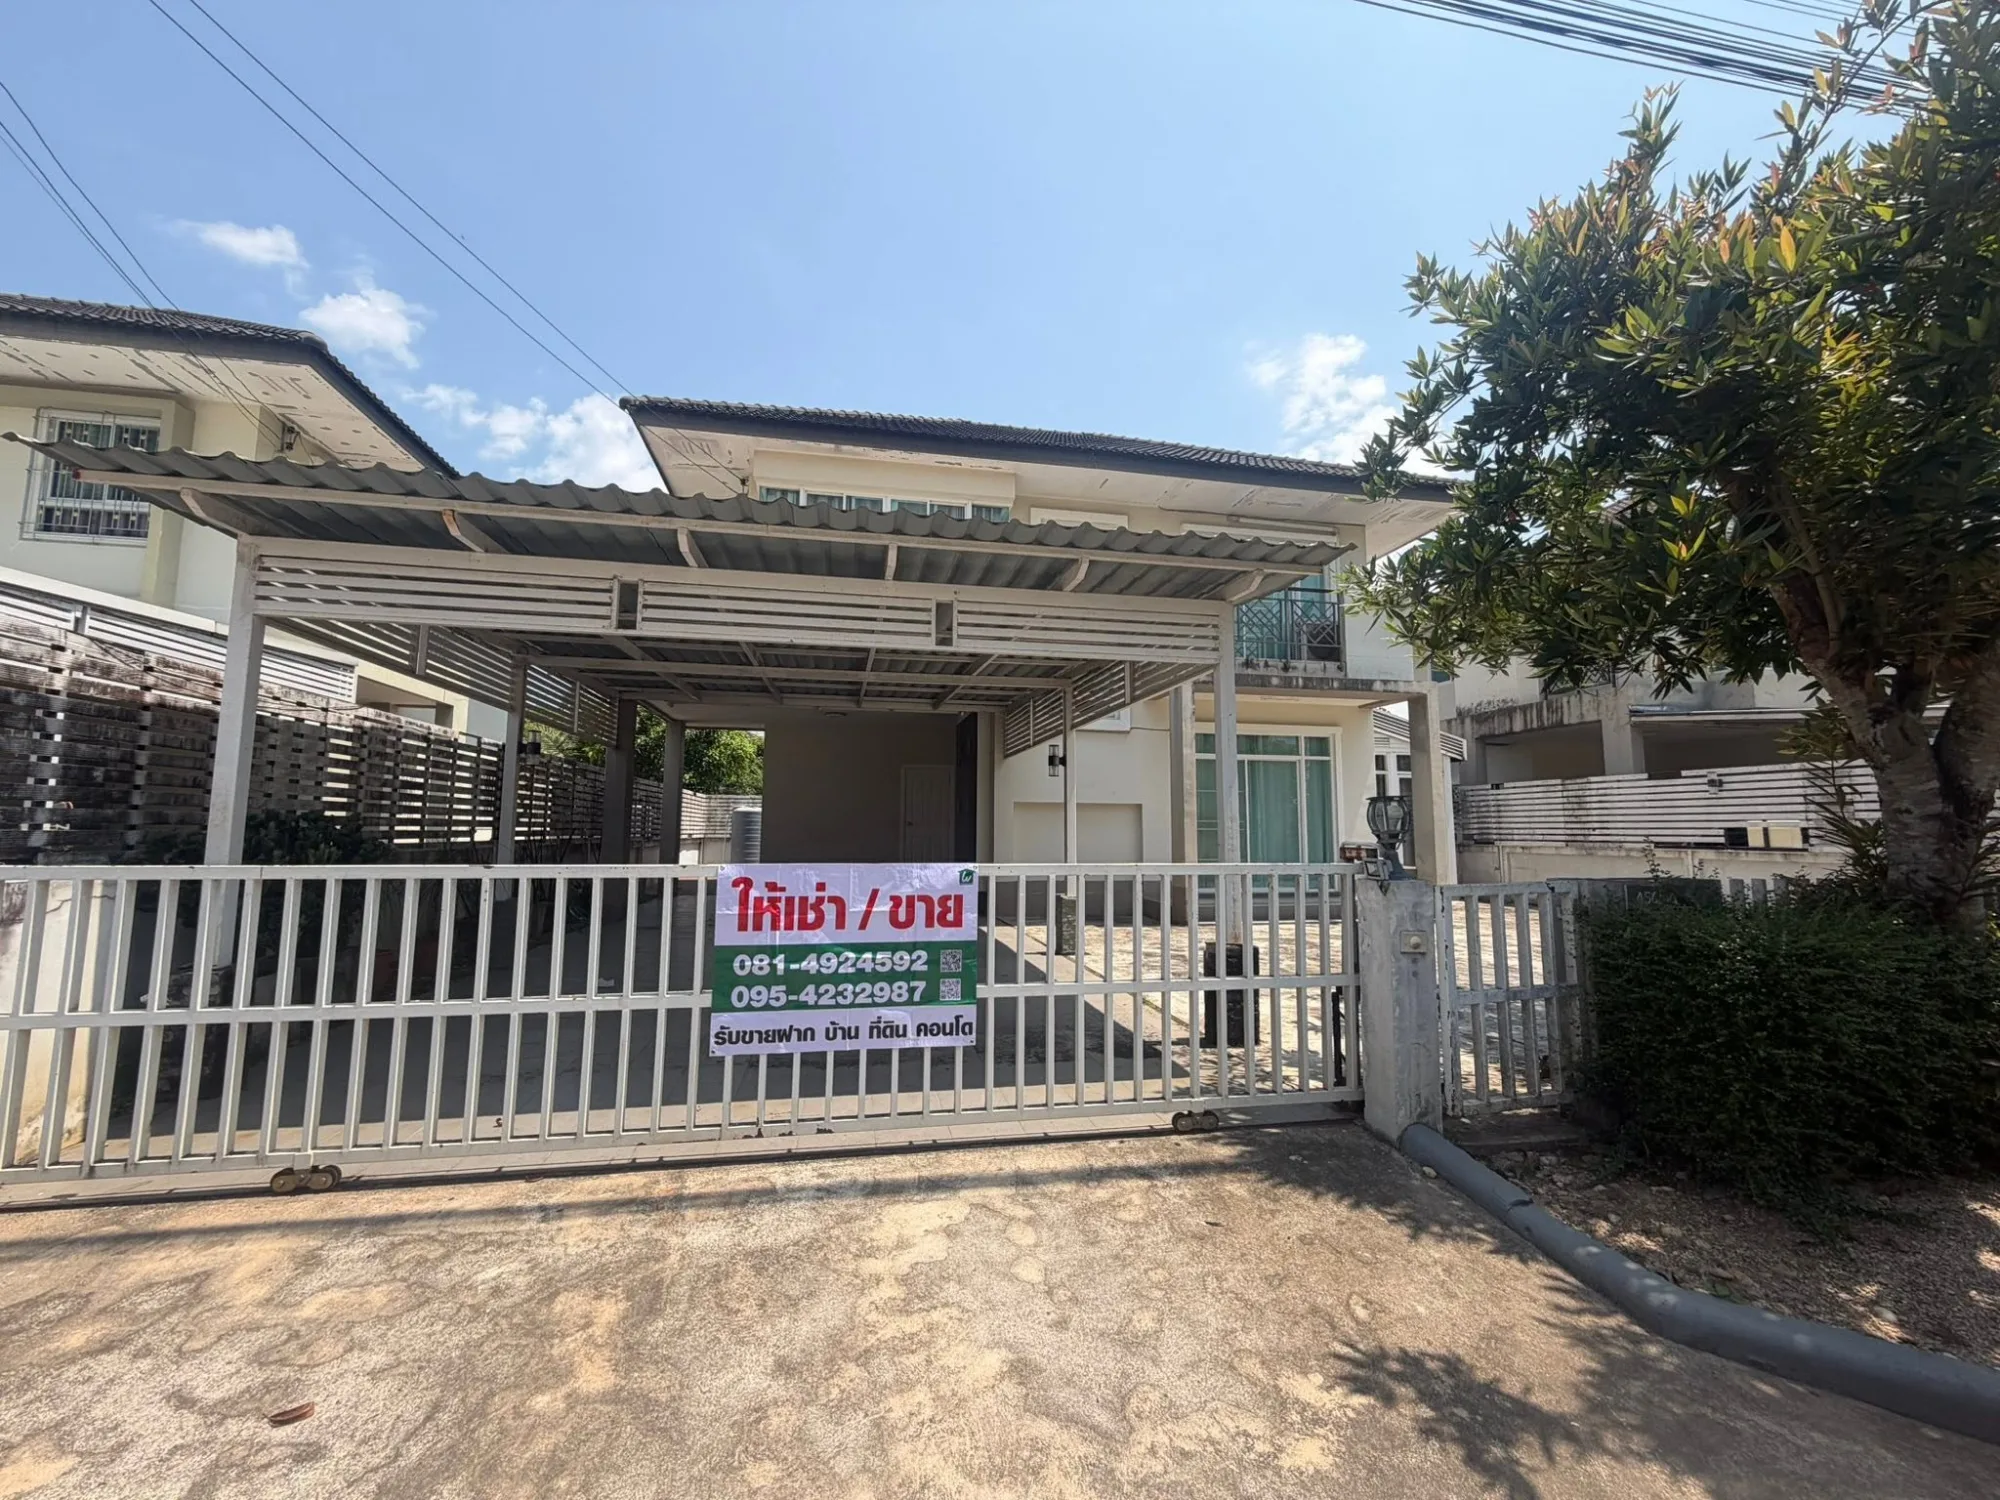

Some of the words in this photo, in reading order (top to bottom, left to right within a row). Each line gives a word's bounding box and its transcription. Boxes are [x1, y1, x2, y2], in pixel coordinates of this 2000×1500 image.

[731, 876, 847, 932] ให้เช่า
[857, 888, 880, 931] /
[889, 893, 964, 929] ขาย
[732, 950, 929, 976] 081-4924592
[730, 981, 927, 1008] 095-4232987
[713, 1025, 816, 1046] รับขายฝาก
[825, 1020, 860, 1041] บ้าน
[868, 1016, 908, 1039] ที่ดิน
[916, 1014, 974, 1038] คอนโด
